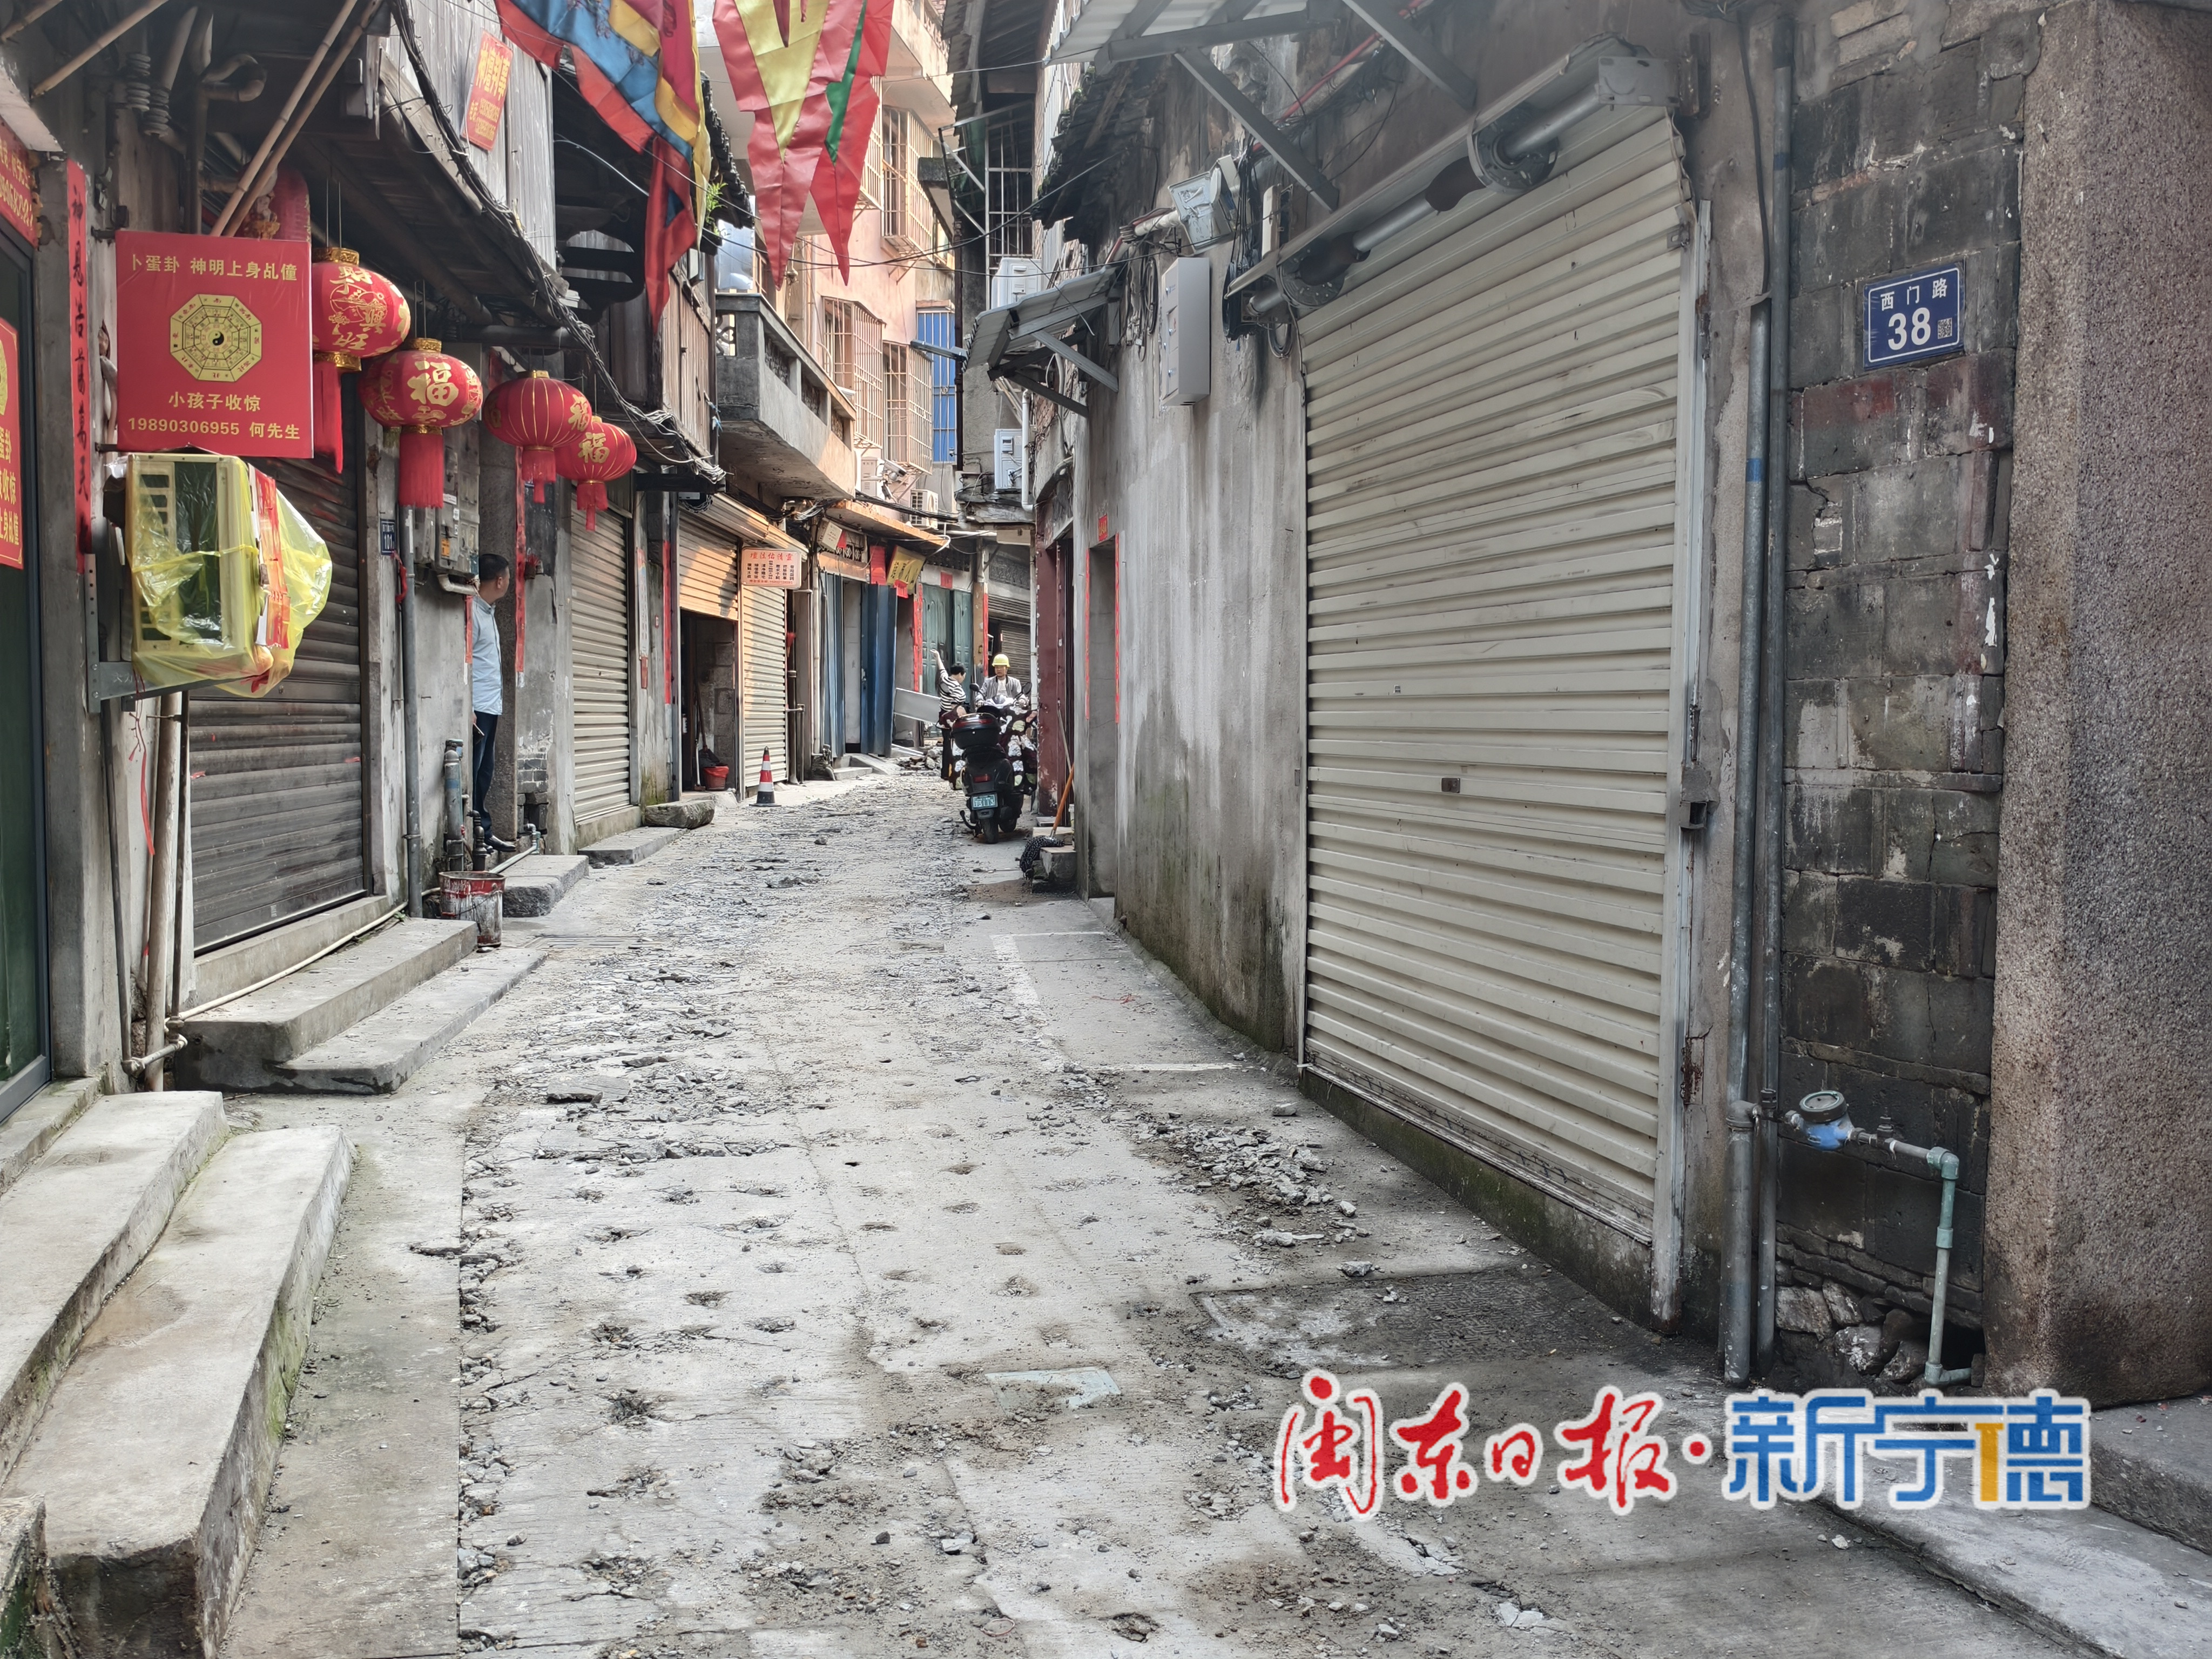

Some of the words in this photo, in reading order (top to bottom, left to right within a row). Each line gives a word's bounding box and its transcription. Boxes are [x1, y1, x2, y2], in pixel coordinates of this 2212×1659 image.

[132, 254, 180, 274] 卜蛋卦
[1880, 277, 1947, 311] 西门路
[1888, 307, 1931, 350] 38
[407, 360, 459, 407] 福
[168, 391, 261, 412] 小孩子收惊
[128, 417, 240, 435] 19890306955
[249, 421, 301, 440] 何先生
[578, 431, 610, 463] 福
